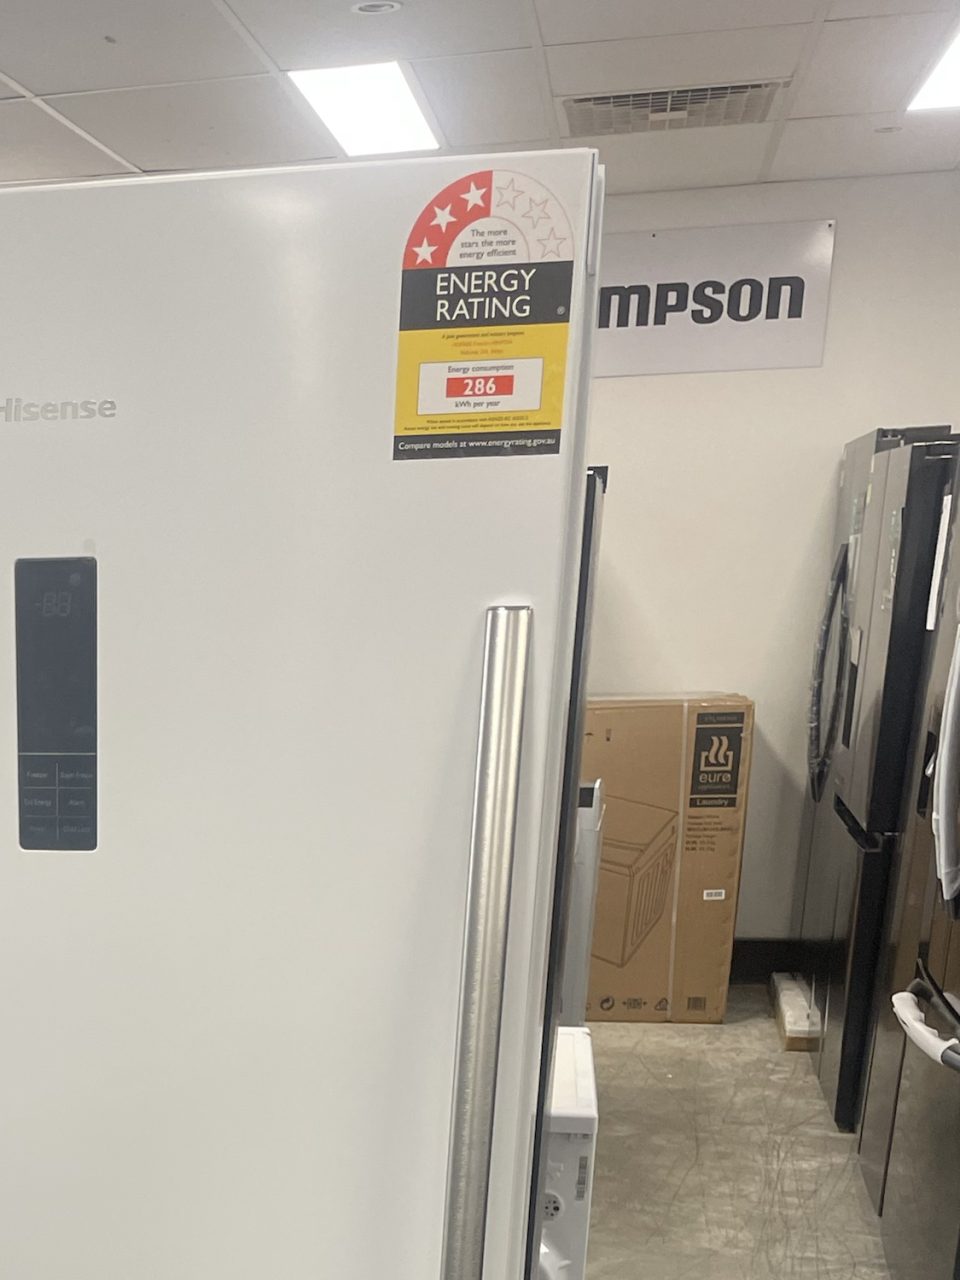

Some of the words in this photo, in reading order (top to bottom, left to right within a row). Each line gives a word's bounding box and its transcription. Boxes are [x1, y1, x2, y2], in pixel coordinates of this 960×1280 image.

[471, 229, 485, 237] The
[460, 251, 484, 260] energy
[487, 248, 517, 257] efficient
[435, 268, 536, 295] ENERGY
[435, 296, 531, 321] RATING
[448, 366, 470, 374] Energy
[463, 377, 496, 395] 286
[398, 441, 431, 451] Compare
[432, 440, 458, 448] models
[700, 773, 732, 783] euro
